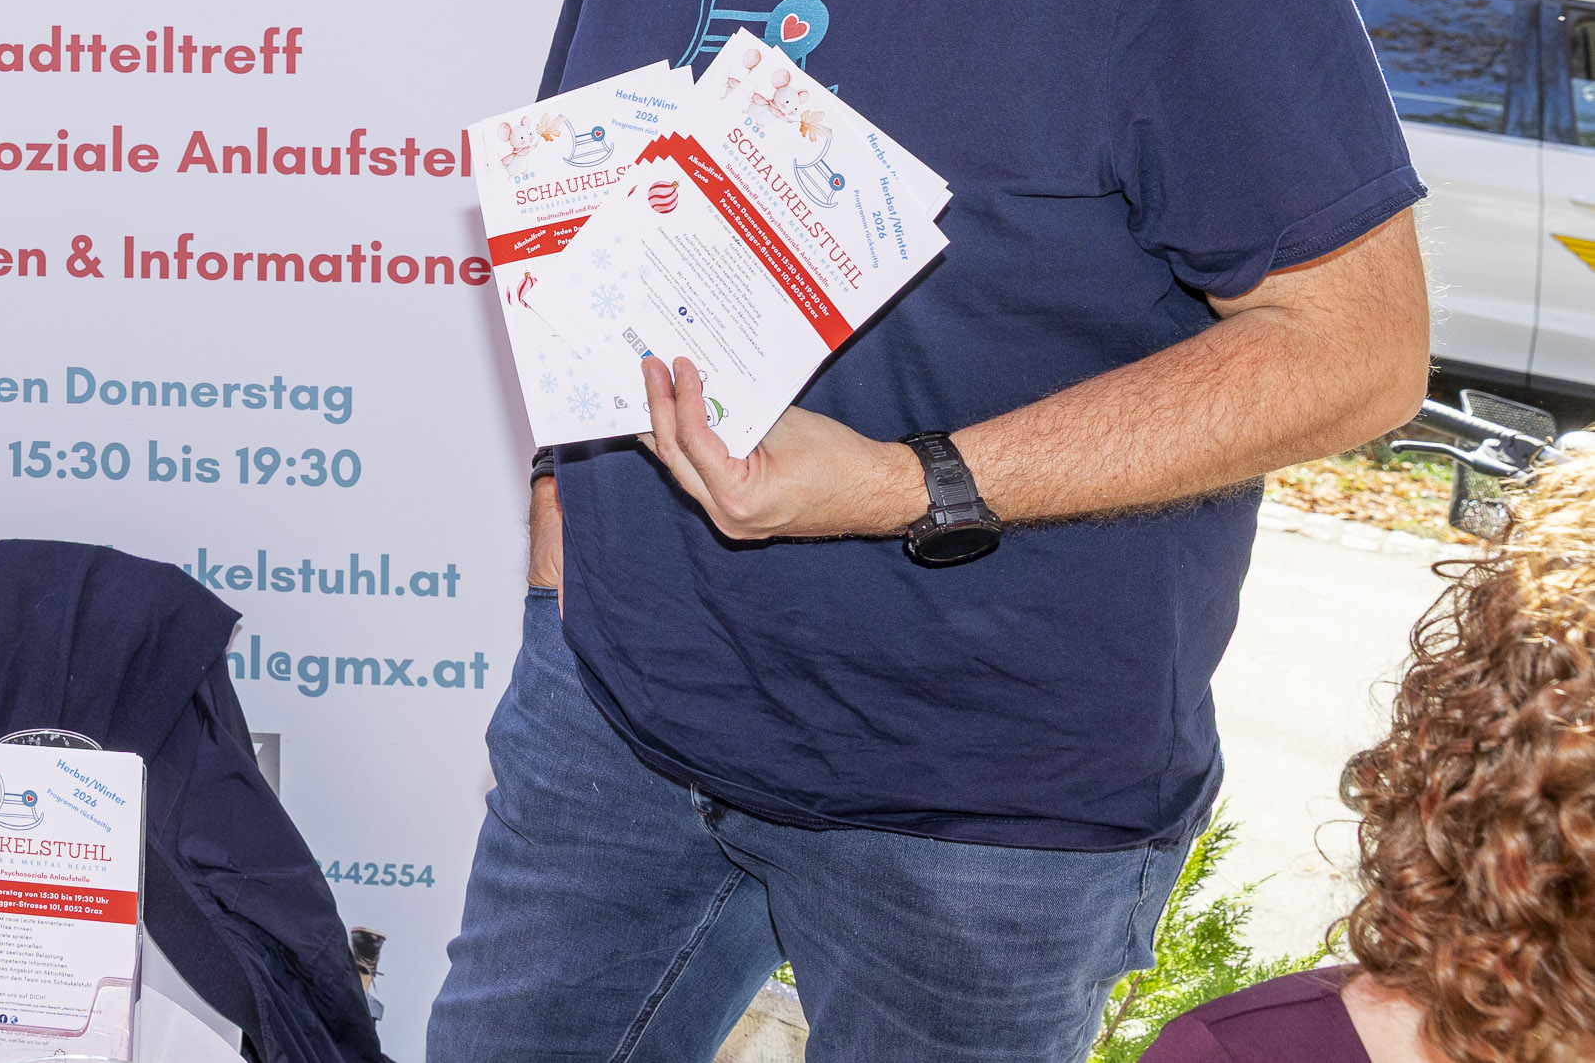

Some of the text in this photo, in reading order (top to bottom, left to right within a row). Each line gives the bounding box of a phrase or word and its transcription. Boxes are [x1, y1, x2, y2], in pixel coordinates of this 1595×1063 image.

[616, 89, 678, 111] Herbst/Wint
[612, 119, 644, 133] Programm
[635, 110, 658, 123] 2026
[744, 115, 766, 139] Das
[177, 127, 471, 177] Anlaufstel
[514, 171, 536, 185] Das
[689, 153, 724, 182] Alkoholfreie
[693, 168, 709, 184] Zone
[516, 164, 632, 205] SCHAUKELS
[521, 194, 588, 215] WOHLBEFINDEN
[722, 141, 778, 208] WOHLBEFINDEN
[787, 219, 818, 256] MENTAL
[819, 258, 850, 293] HEALTH
[727, 124, 867, 290] SCHAUKELSTUHL
[854, 189, 868, 229] Programm
[553, 227, 572, 237] Jeden
[725, 162, 830, 288] Stadtteiltreff und Psychosoziale Anlaufstelle
[872, 211, 887, 239] 2026
[880, 177, 908, 261] Herbst/Winter
[514, 229, 546, 251] Alkoholfreie
[526, 243, 540, 254] Zone
[723, 187, 831, 316] Jeden Donnerstag von 15:30 bis 19:30 Uhr
[66, 235, 104, 278] &
[124, 233, 491, 286] Informatione
[718, 197, 819, 318] Peter-Rosegger-Strasse 101, 8052 Graz
[67, 367, 352, 424] Donnerstag
[9, 441, 130, 480] 15:30
[149, 440, 220, 483] bis
[236, 447, 361, 487] 19:30
[56, 758, 126, 806] Herbst/Winter
[45, 788, 79, 812] Programm
[72, 788, 97, 807] 2026
[0, 869, 47, 880] Psychosoziale
[49, 873, 90, 883] Anlaufstelle
[21, 859, 62, 868] MENTAL
[68, 863, 107, 872] HEALTH
[315, 859, 435, 888] 442554
[40, 891, 58, 899] 15:30
[60, 893, 71, 901] bis
[74, 894, 93, 903] 19:30
[95, 896, 108, 904] Uhr
[49, 903, 62, 912] 101,
[64, 905, 82, 913] 8052
[84, 906, 102, 914] Graz
